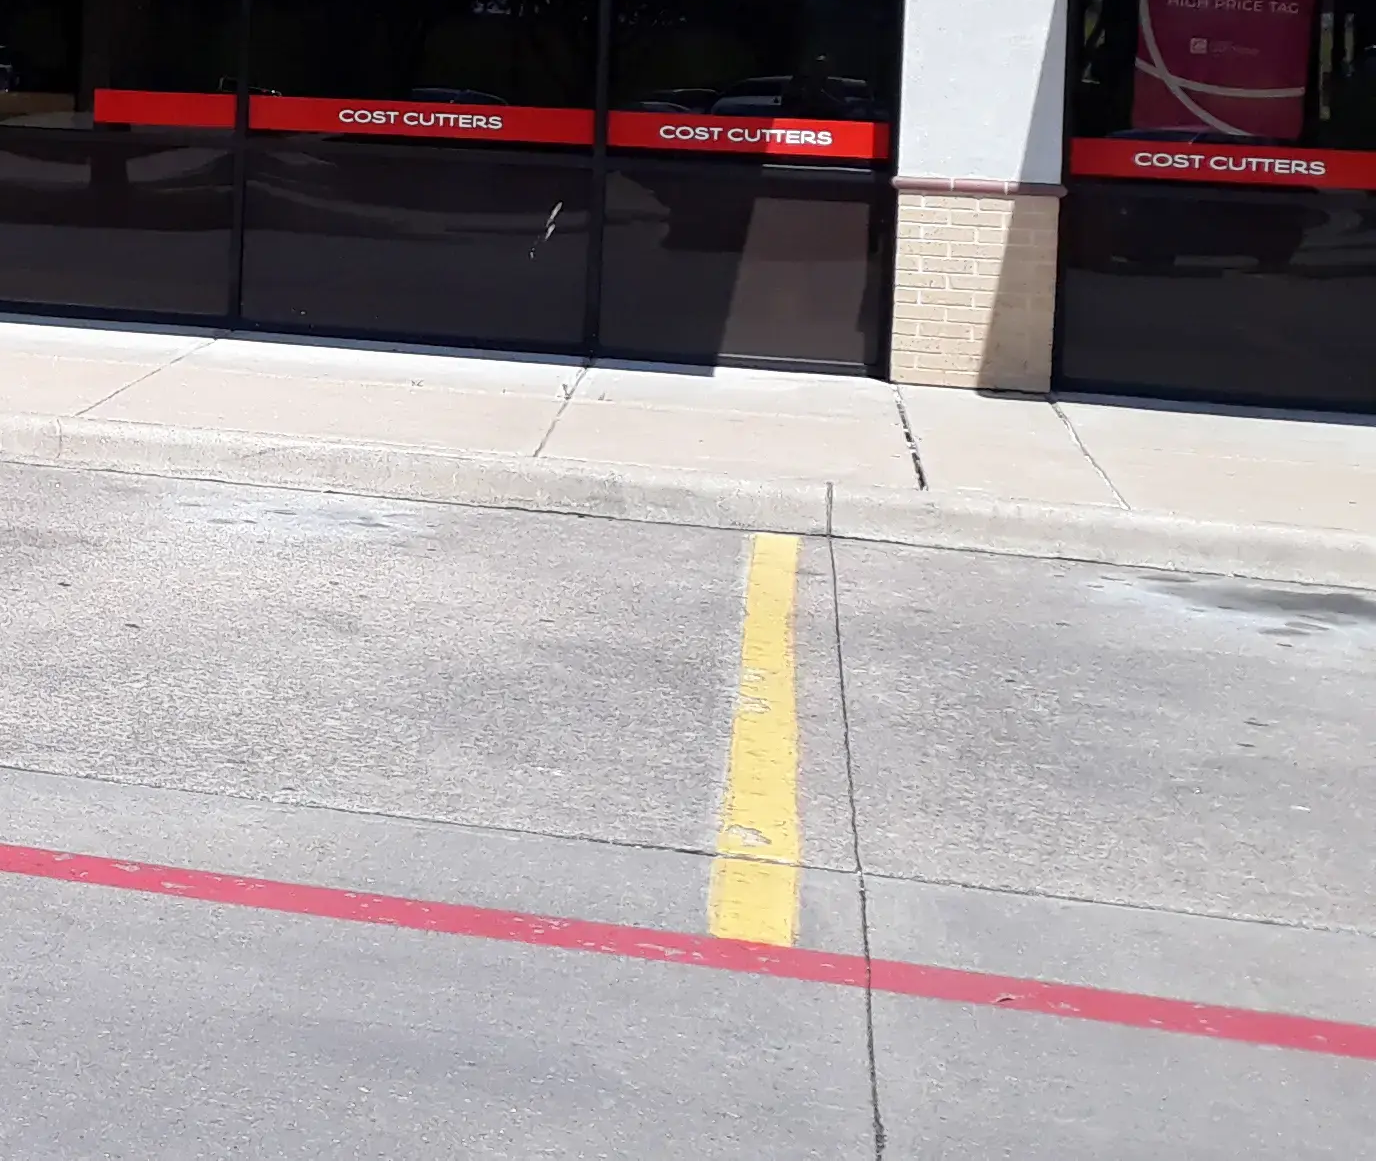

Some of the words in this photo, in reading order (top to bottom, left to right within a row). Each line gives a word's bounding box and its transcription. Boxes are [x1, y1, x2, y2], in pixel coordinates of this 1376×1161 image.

[1269, 1, 1300, 14] TAG
[339, 109, 399, 124] COST
[403, 112, 503, 129] CUTTERS
[659, 125, 723, 141] COST
[727, 128, 833, 145] CUTTERS
[1134, 152, 1204, 169] COST
[1209, 155, 1326, 176] CUTTERS
